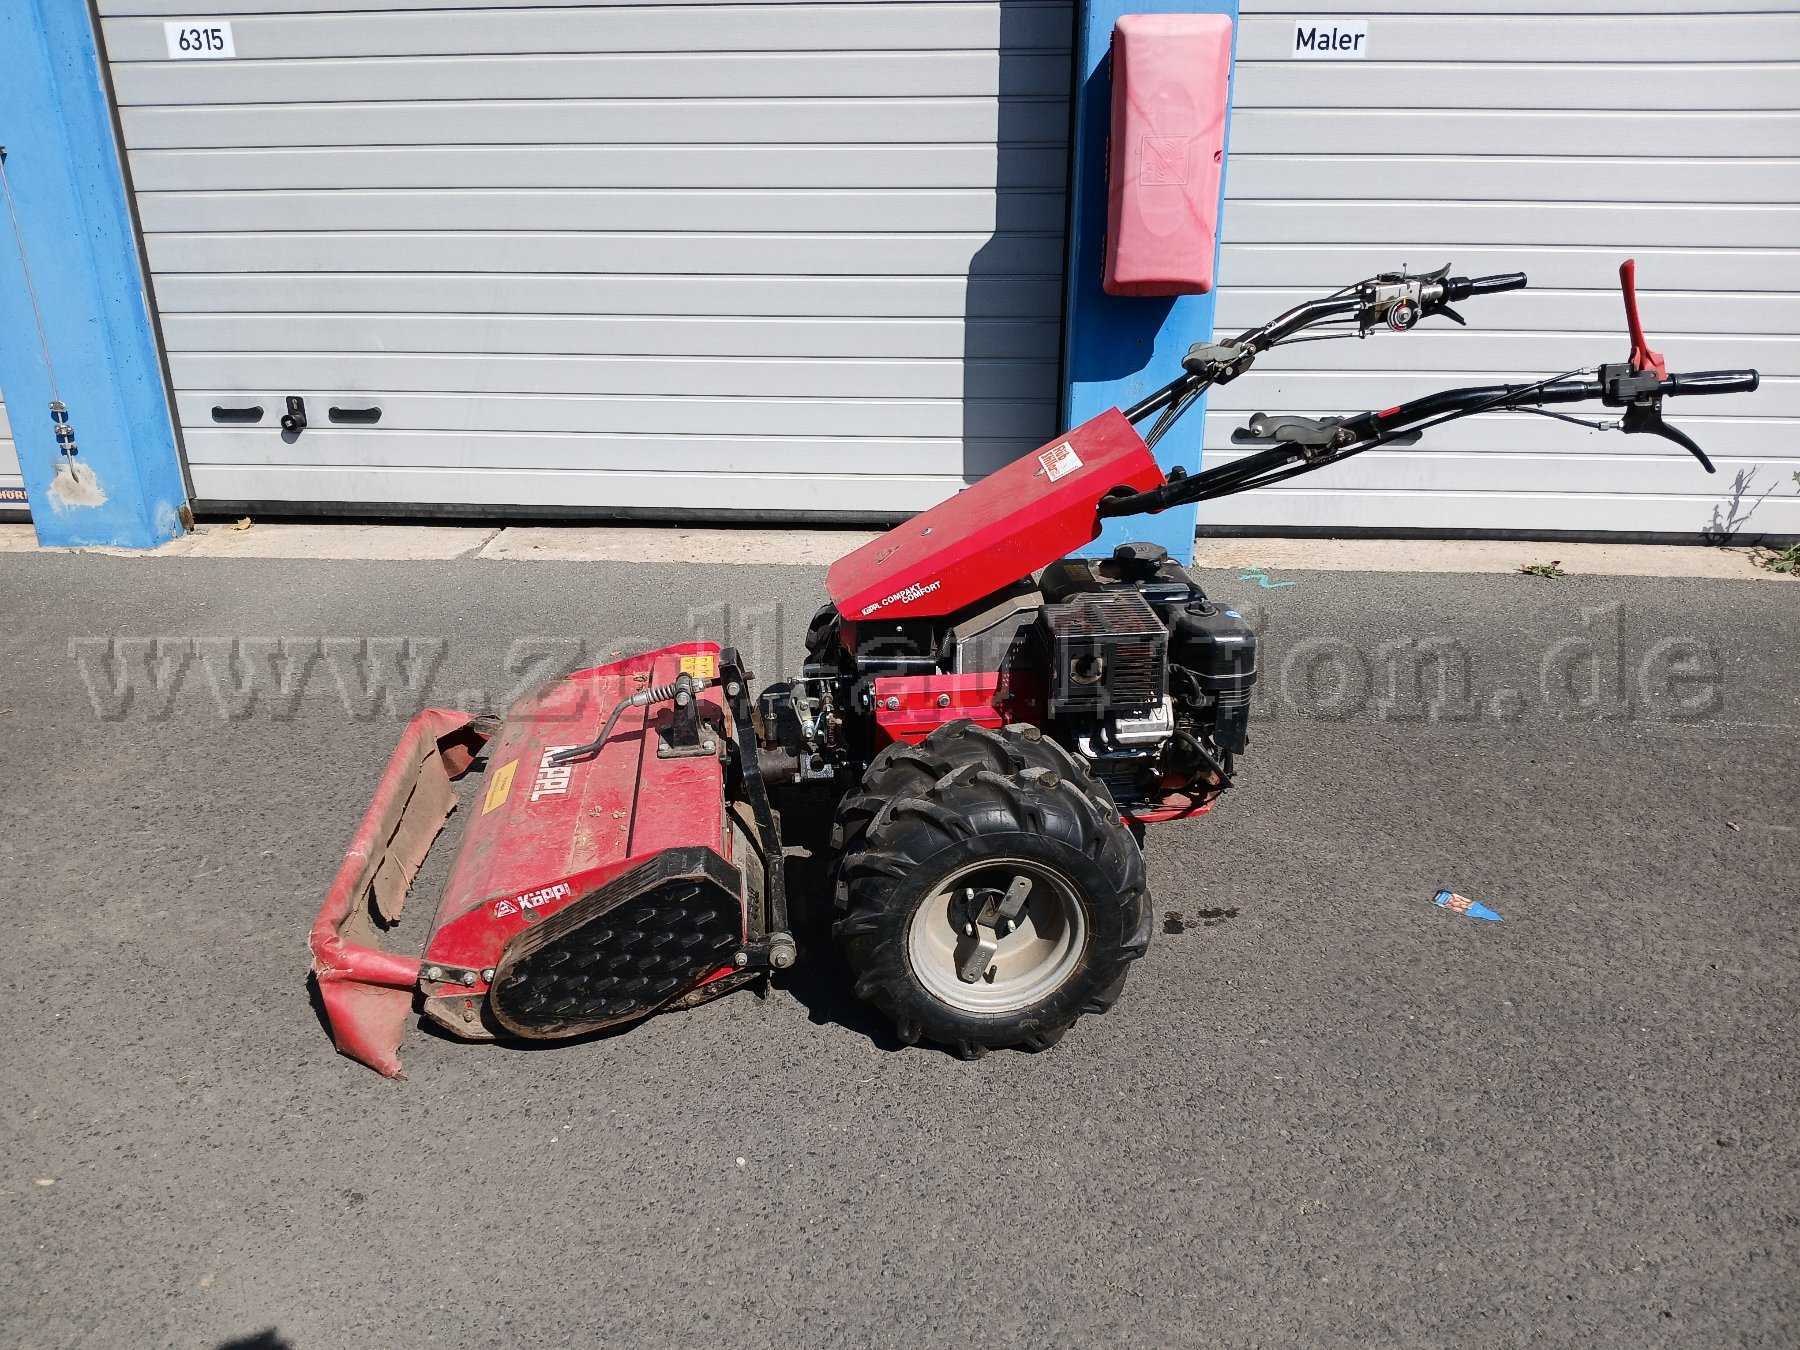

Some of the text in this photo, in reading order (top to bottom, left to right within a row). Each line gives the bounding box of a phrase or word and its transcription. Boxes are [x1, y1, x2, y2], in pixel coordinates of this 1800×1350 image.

[179, 28, 224, 51] 6315
[1296, 27, 1366, 51] Maler
[0, 489, 28, 500] HÖR
[881, 582, 921, 606] COMPAKT
[902, 580, 941, 604] COMFORT
